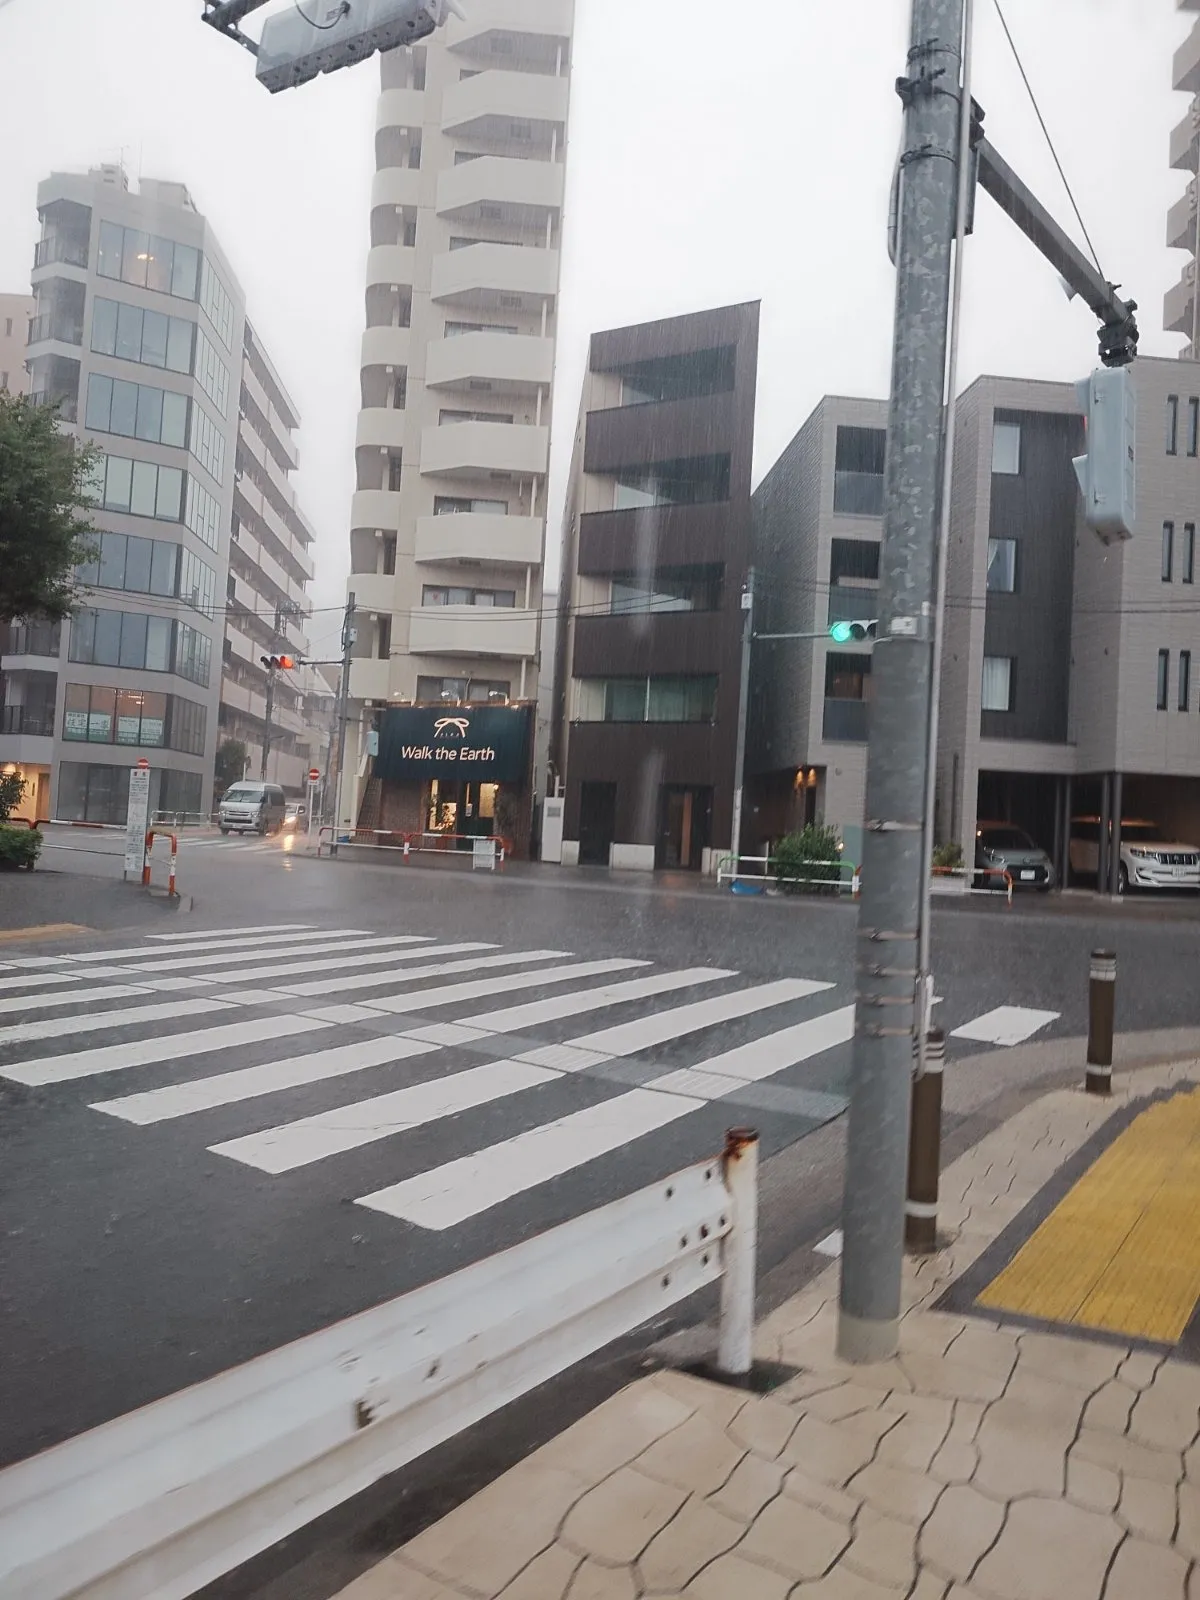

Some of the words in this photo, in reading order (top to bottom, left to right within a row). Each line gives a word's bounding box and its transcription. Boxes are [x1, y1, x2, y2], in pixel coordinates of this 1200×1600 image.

[401, 745, 434, 760] Walk
[435, 746, 457, 761] the
[459, 746, 495, 761] Earth
